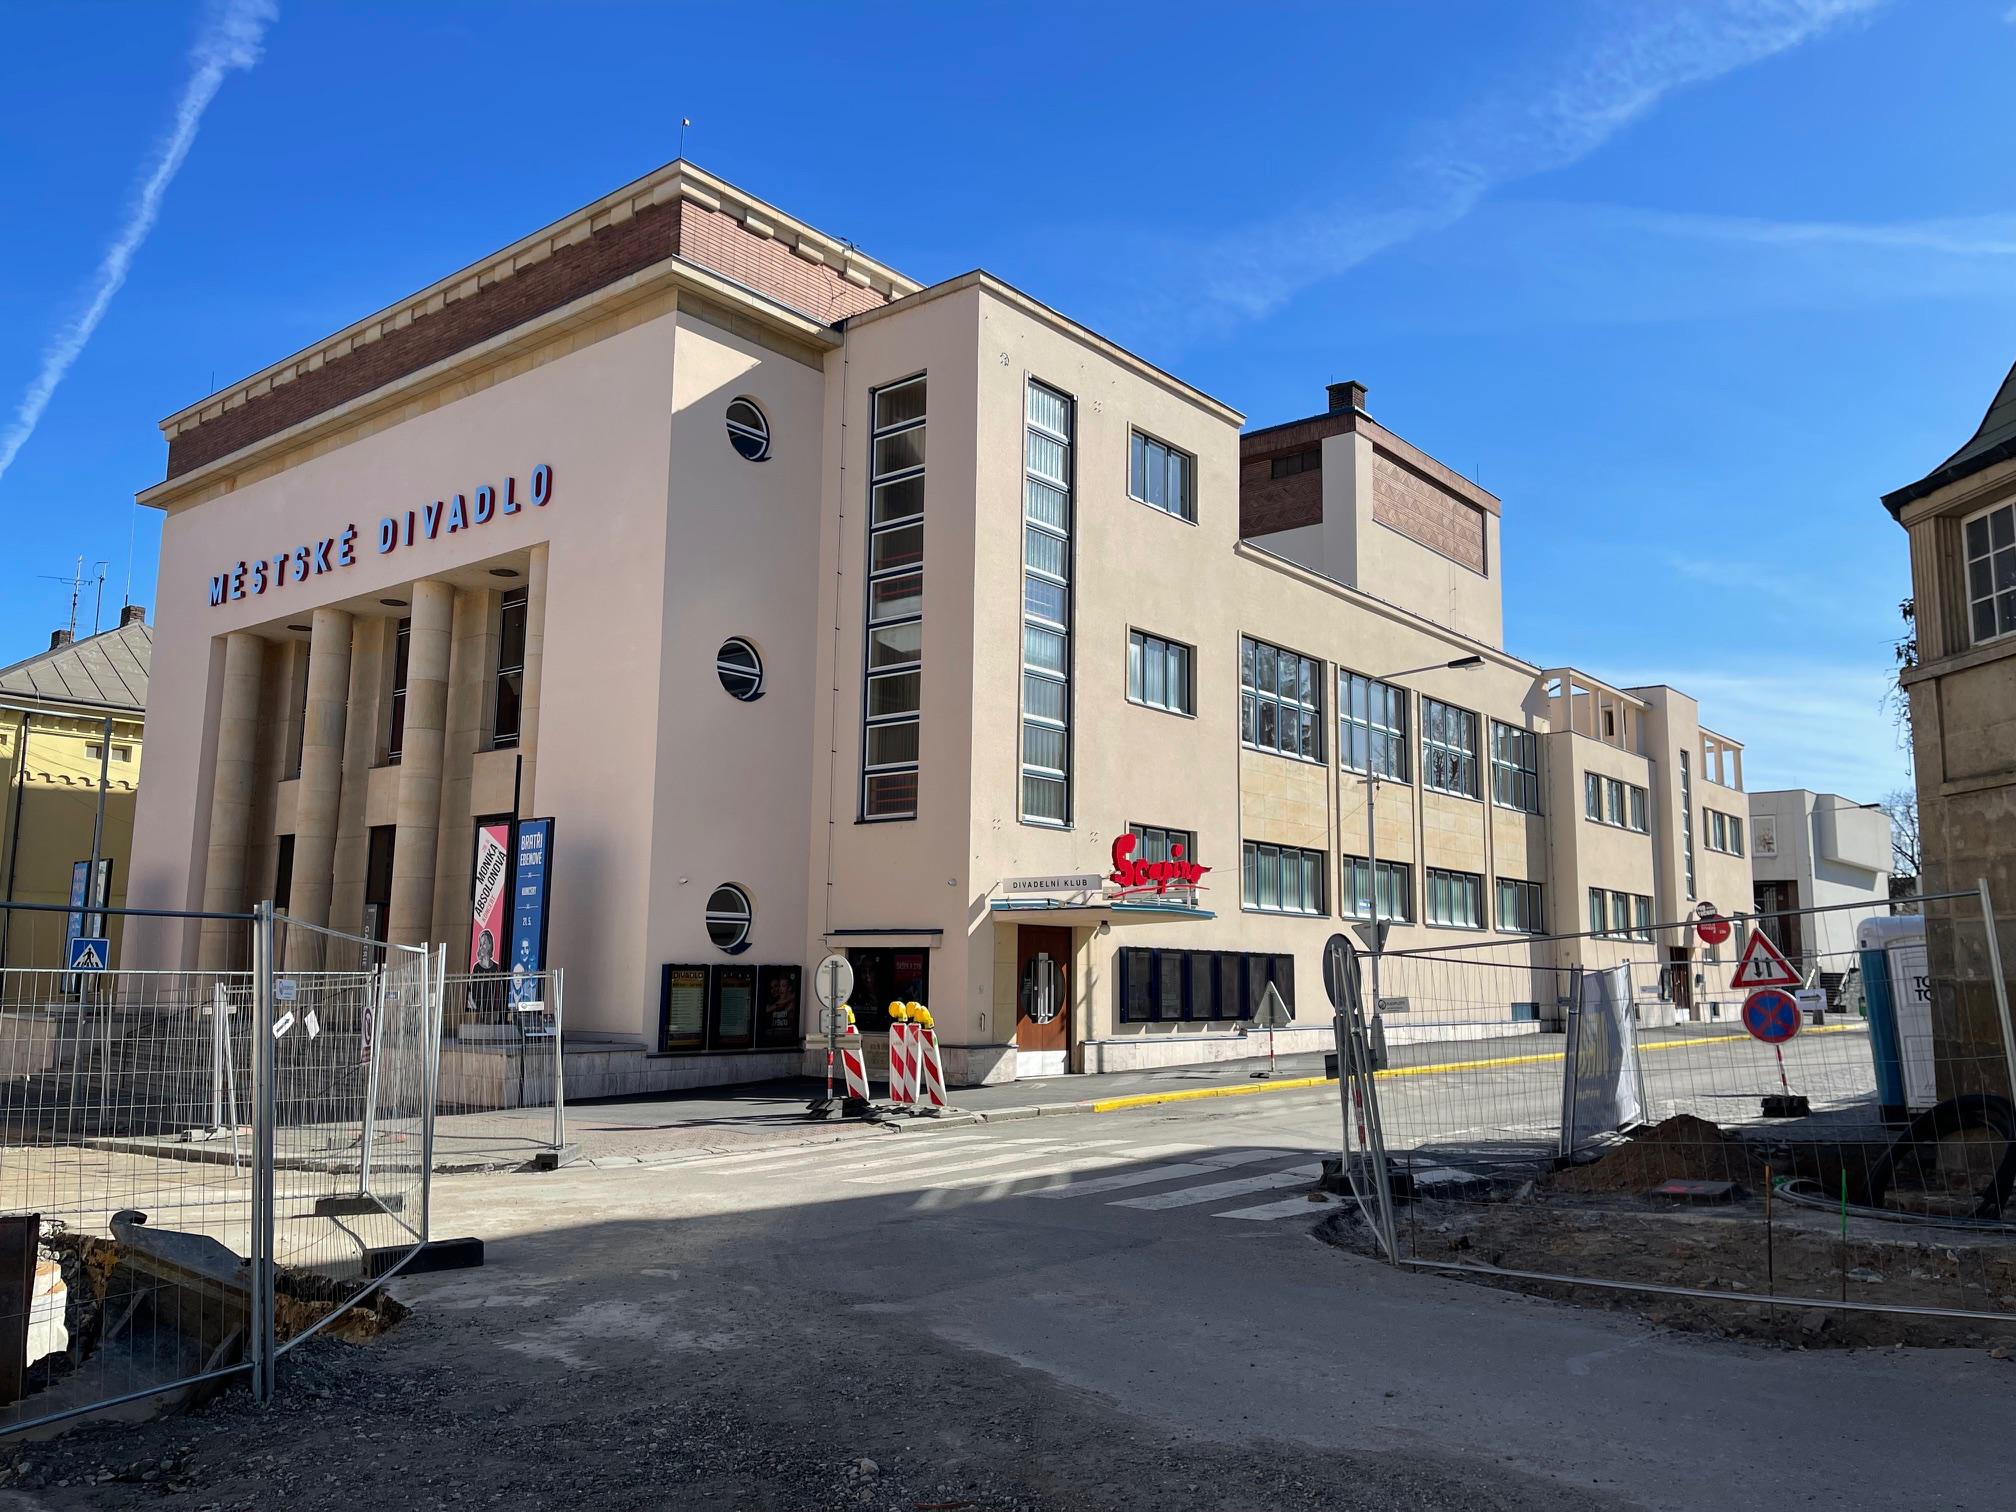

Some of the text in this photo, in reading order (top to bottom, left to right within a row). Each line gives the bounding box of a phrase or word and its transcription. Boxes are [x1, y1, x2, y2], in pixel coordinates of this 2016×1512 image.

[378, 463, 553, 554] DIVADLO
[476, 843, 498, 885] MONIKA
[1012, 878, 1088, 889] DIVADELNÍ KLUB
[361, 925, 370, 967] GAERIE
